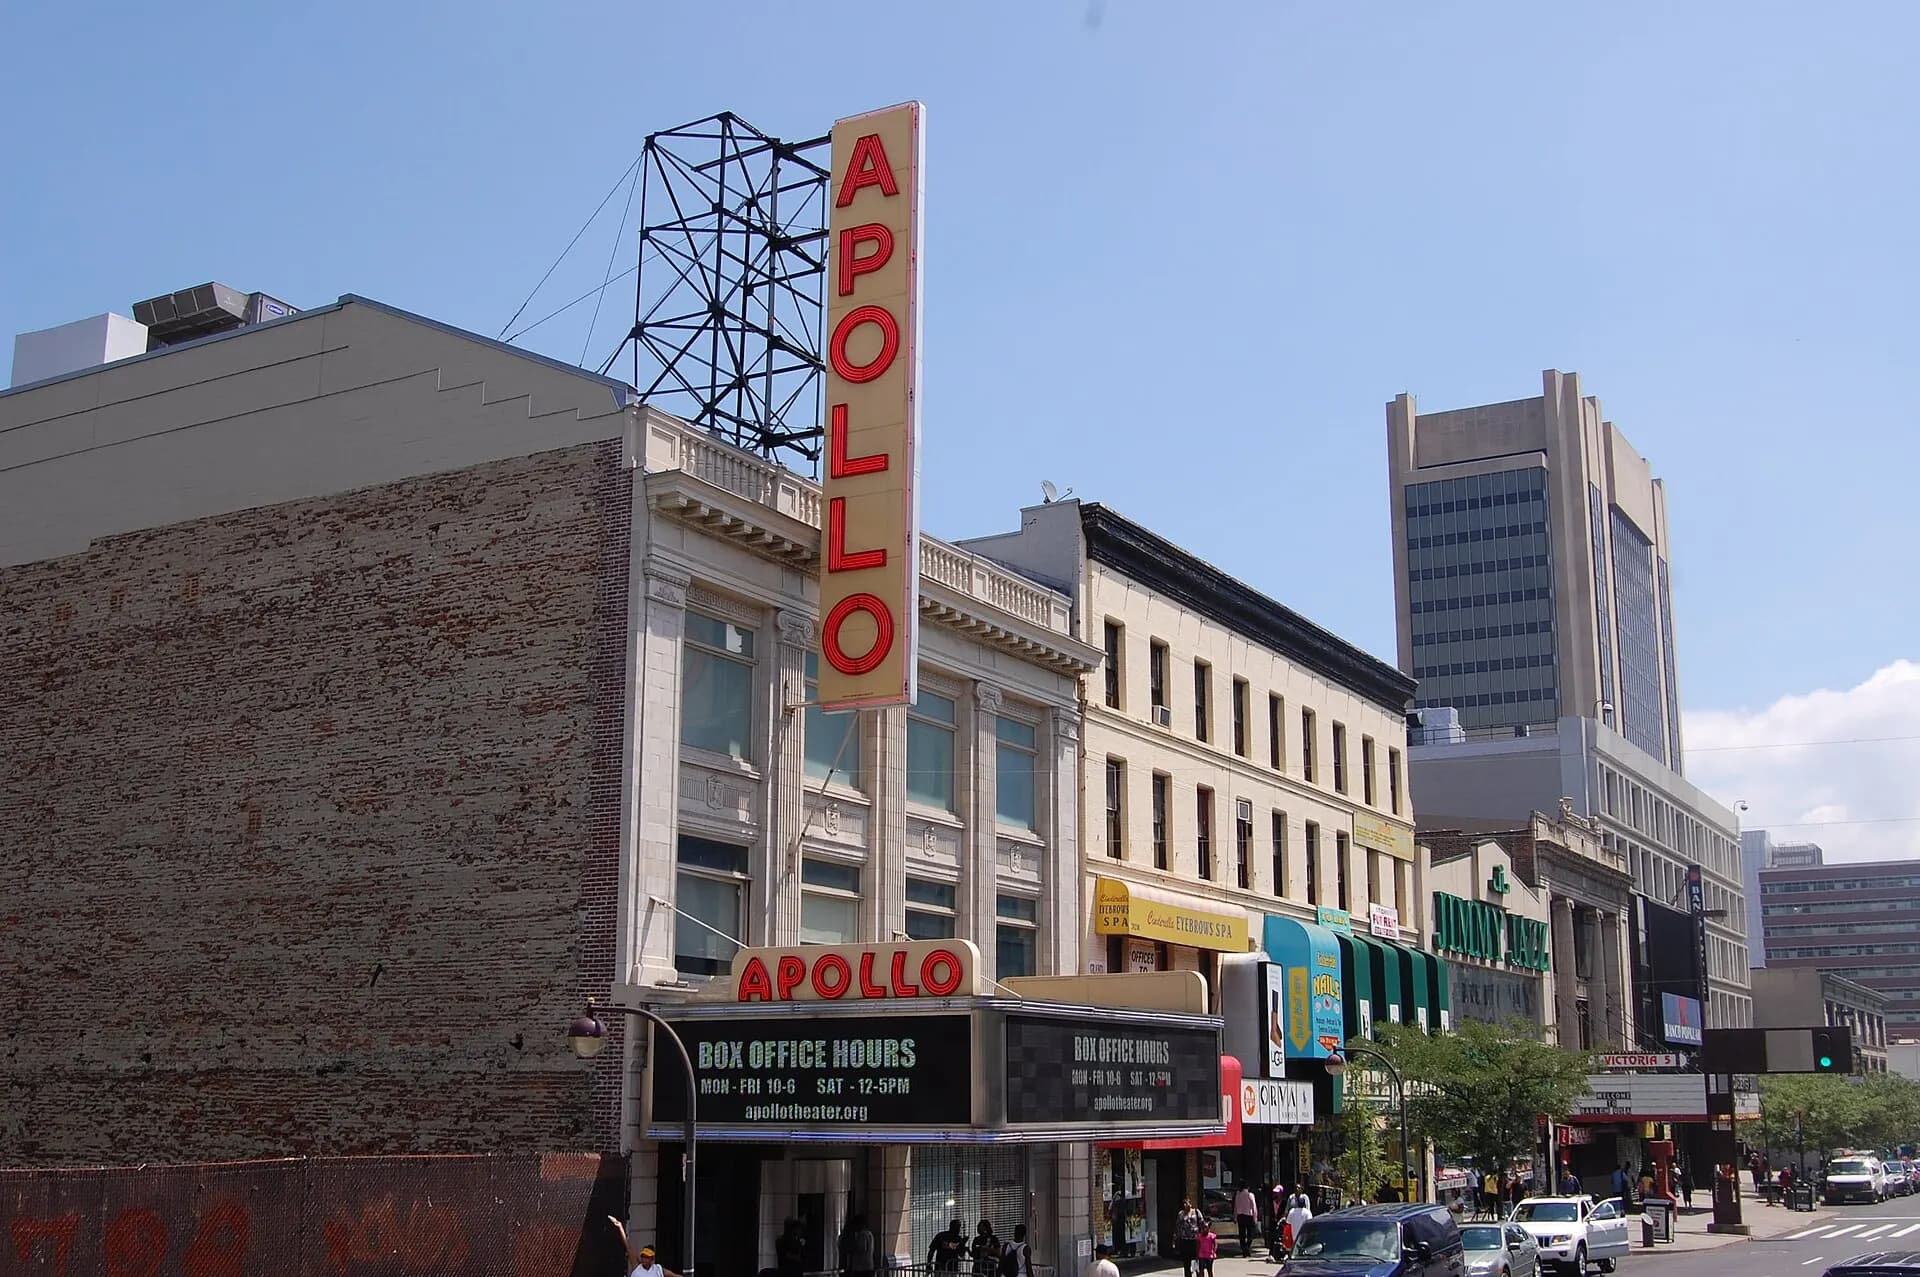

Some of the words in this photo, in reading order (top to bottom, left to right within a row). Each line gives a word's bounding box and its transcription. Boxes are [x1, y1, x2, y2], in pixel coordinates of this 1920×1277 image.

[822, 133, 899, 676] APOLLO
[1104, 917, 1129, 927] SPA
[1176, 916, 1214, 936] EYEBROWS
[1215, 922, 1232, 939] SPA
[1432, 891, 1505, 961] JIMMY
[1505, 913, 1550, 971] JAZZ
[1131, 950, 1154, 965] OFFICES
[738, 949, 963, 1002] APOLLO
[1313, 973, 1340, 1001] NAILS
[698, 1041, 743, 1069] BOX
[749, 1040, 827, 1069] OFFICE
[832, 1038, 917, 1068] HOURS
[1074, 1036, 1096, 1061] BOX
[1099, 1038, 1135, 1063] OFFICE
[1136, 1040, 1169, 1064] HOURS
[1604, 1056, 1657, 1065] VICTORIA
[1664, 1056, 1671, 1065] 5
[700, 1078, 729, 1094] MON
[740, 1078, 760, 1094] FRI
[766, 1078, 796, 1094] 10-6
[816, 1077, 843, 1094] SAT
[858, 1077, 910, 1094] 12-5PM
[1072, 1069, 1088, 1085] MON
[1092, 1069, 1104, 1085] FRI
[1106, 1070, 1121, 1085] 10-6
[1130, 1071, 1143, 1086] SAT
[1094, 1095, 1153, 1111] apollotheater.org
[1260, 1084, 1296, 1108] ORVA
[745, 1103, 868, 1122] apollotheater.org
